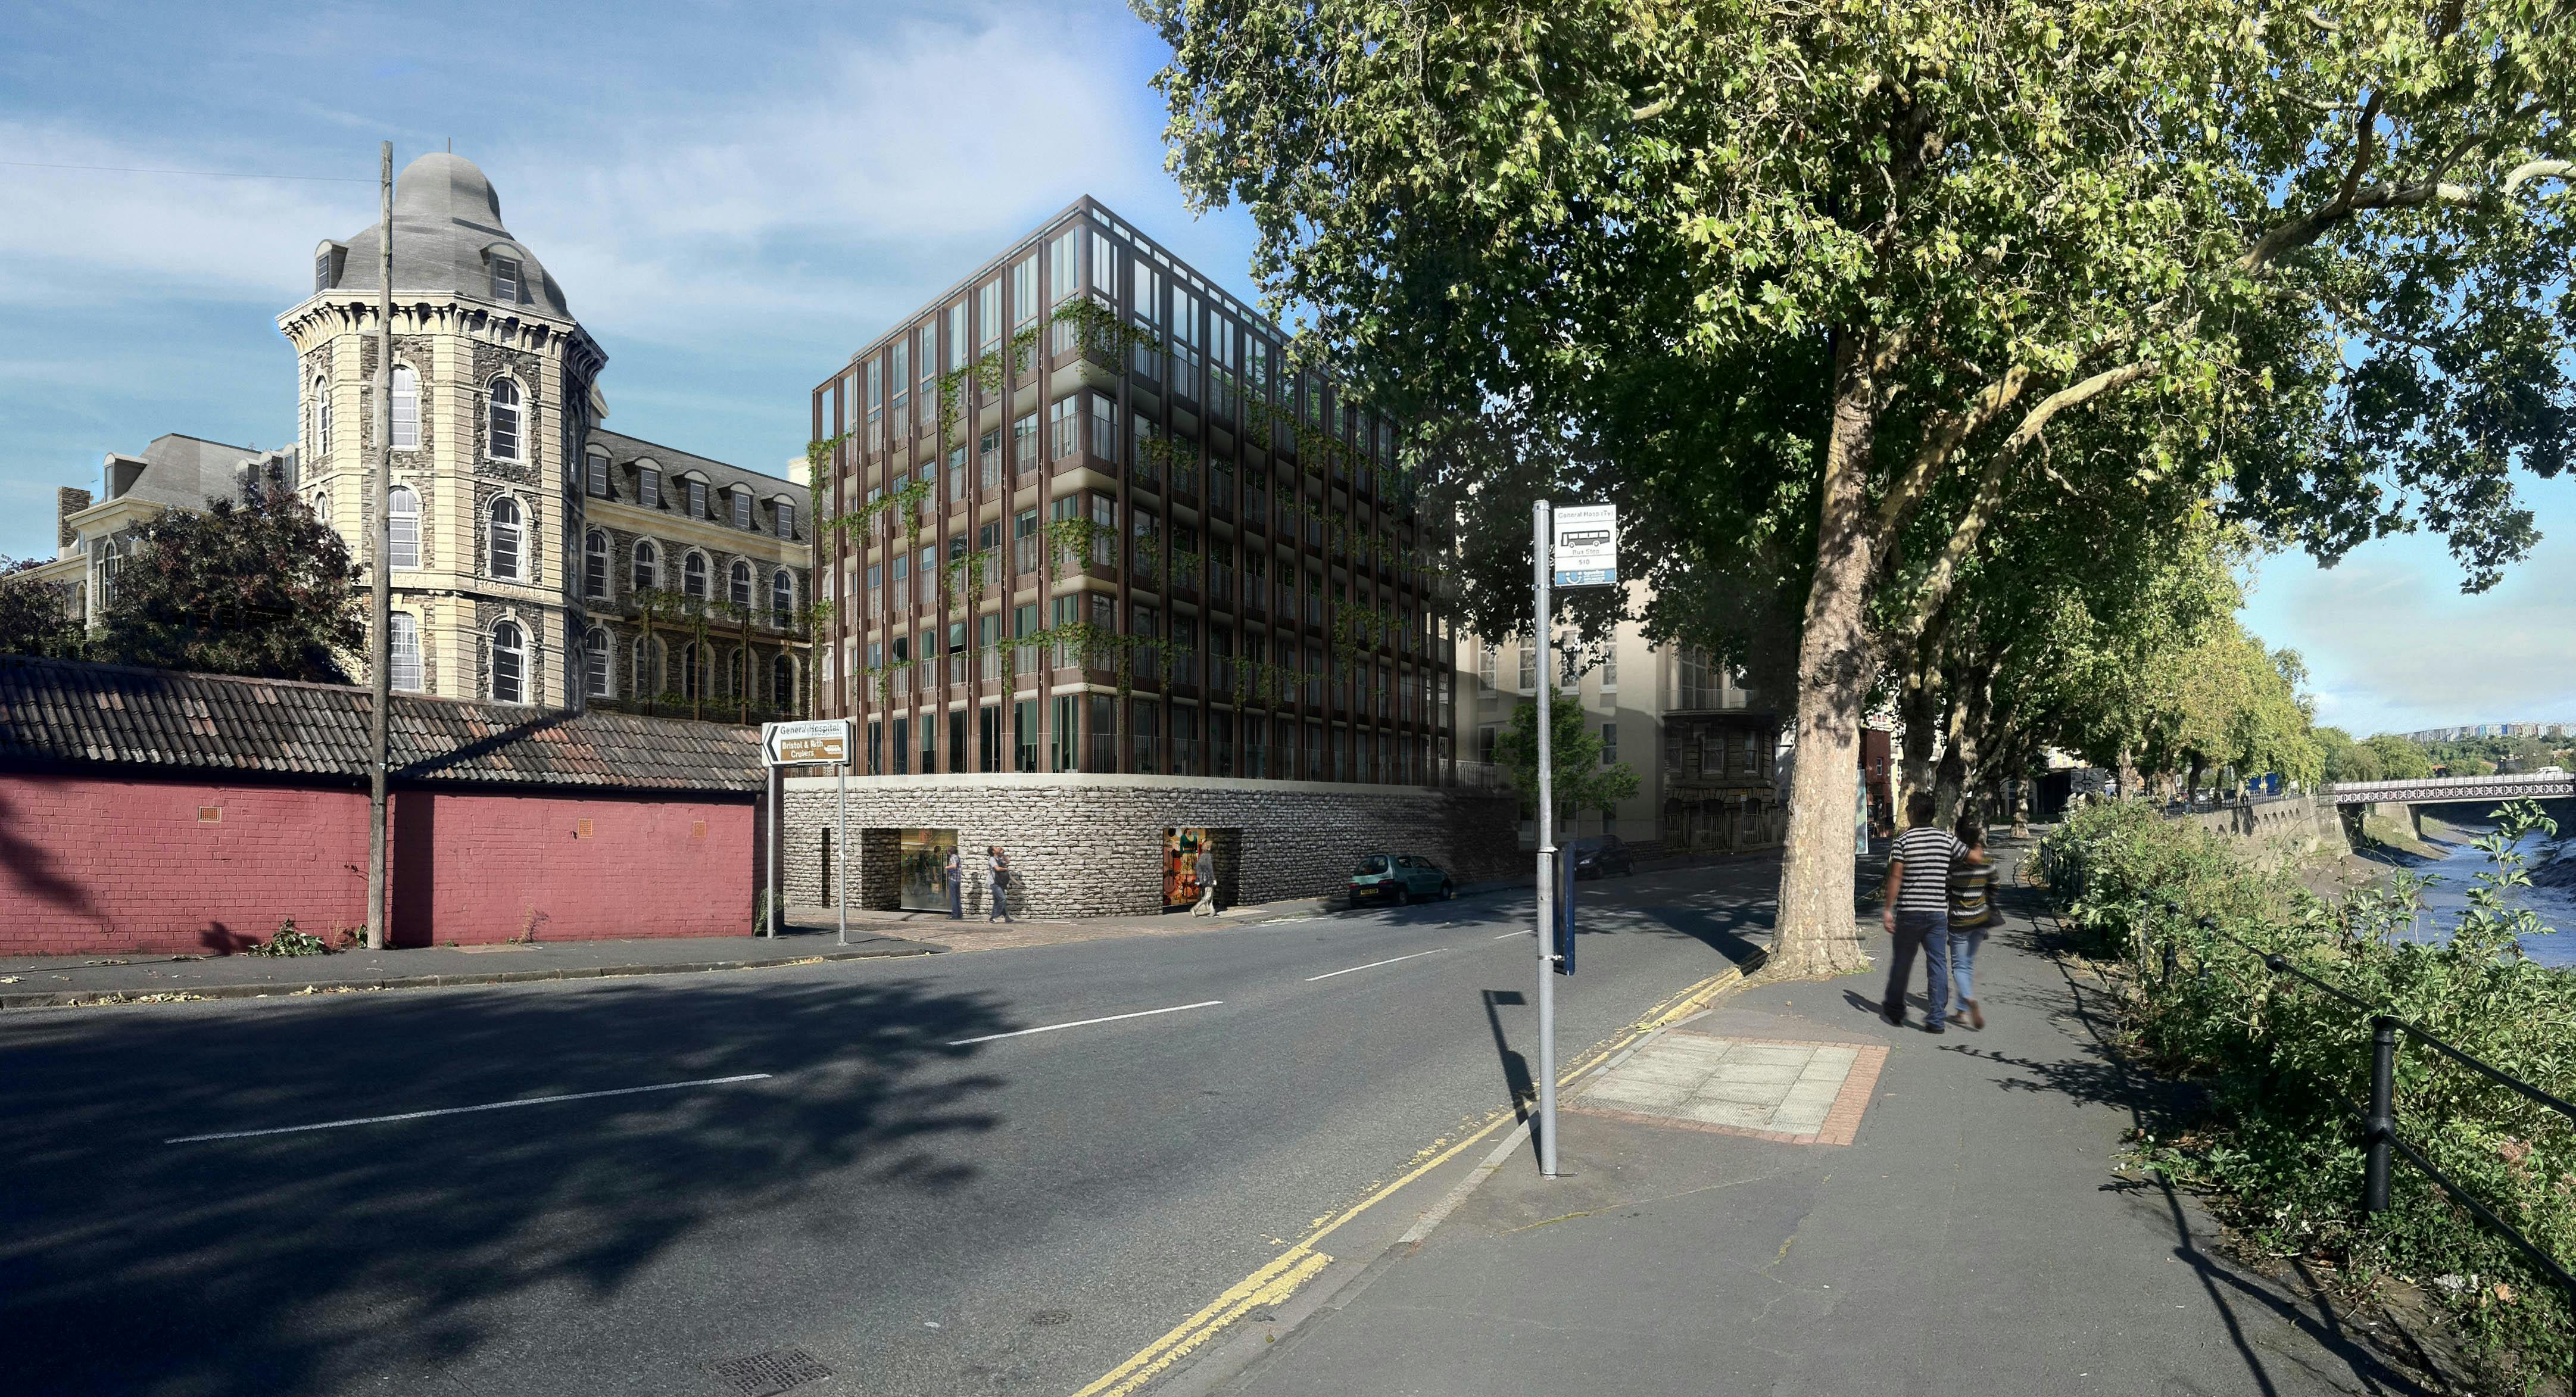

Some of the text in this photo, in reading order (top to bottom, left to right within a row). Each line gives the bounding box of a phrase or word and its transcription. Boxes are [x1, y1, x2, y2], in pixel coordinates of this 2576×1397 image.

[780, 724, 840, 735] General Hospital
[782, 741, 803, 750] Bristol
[804, 740, 809, 749] &
